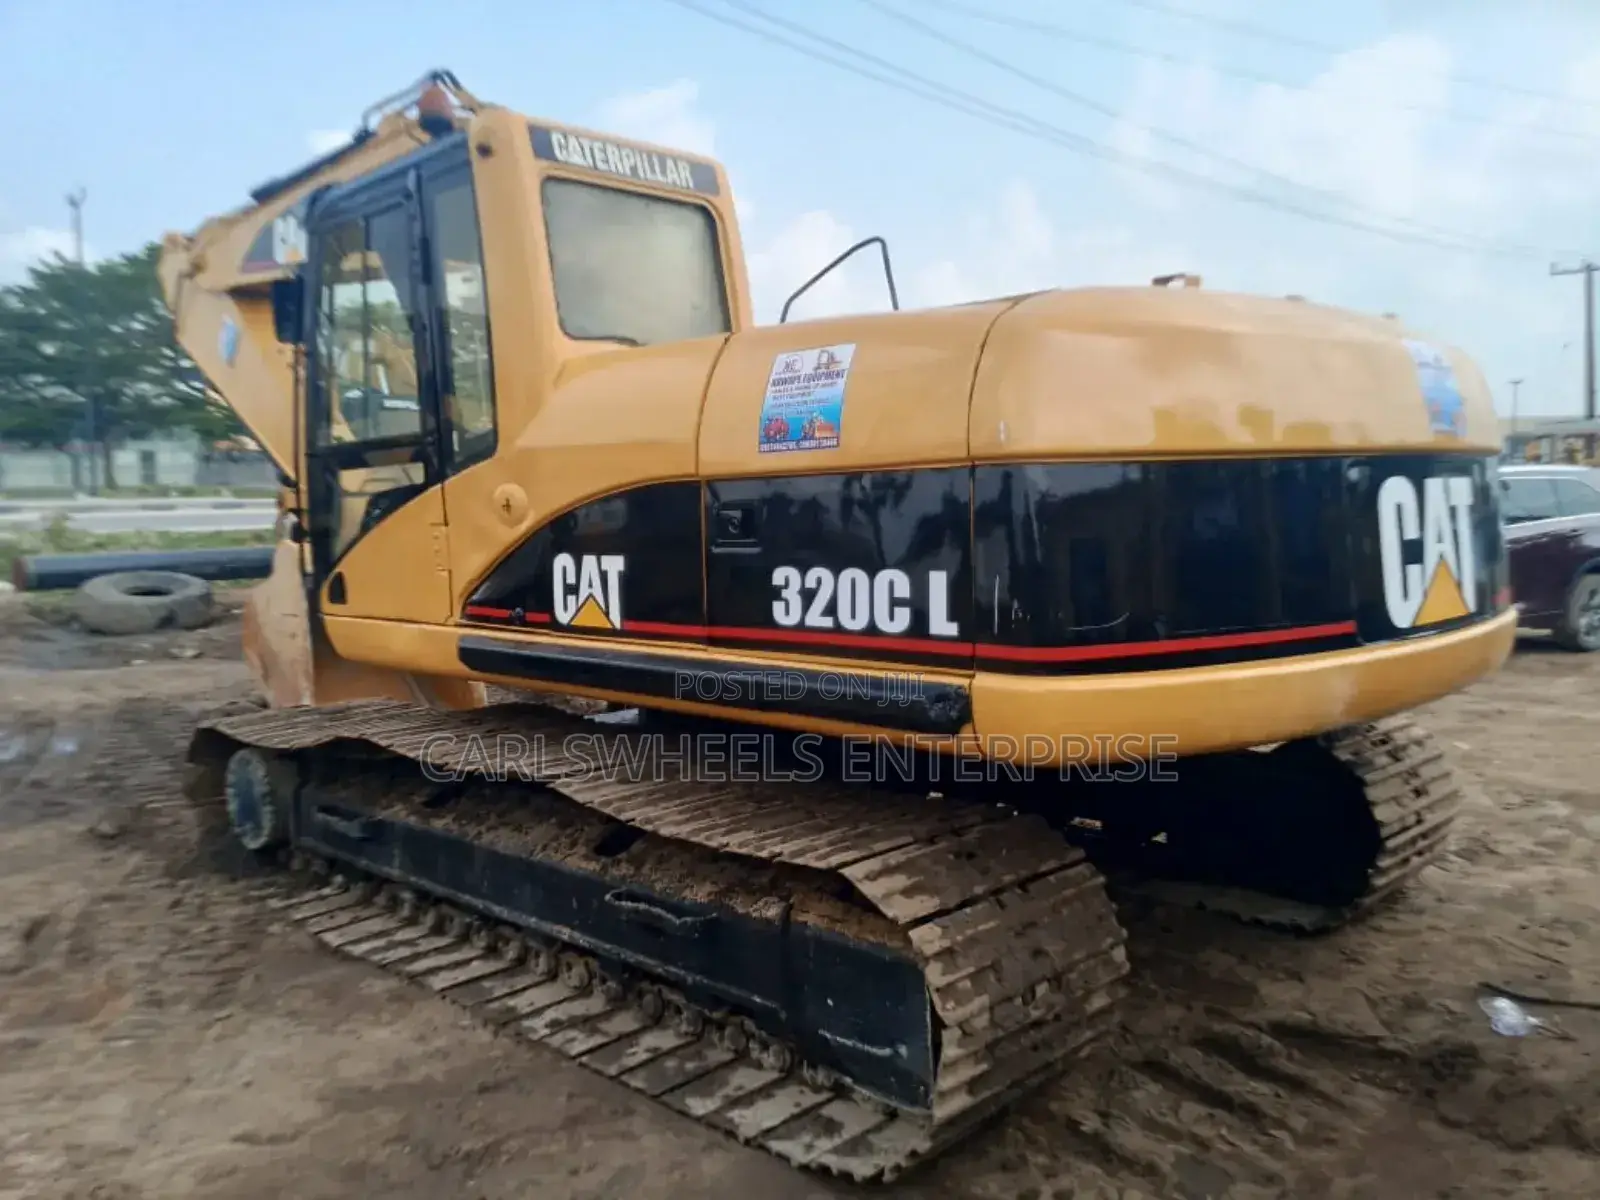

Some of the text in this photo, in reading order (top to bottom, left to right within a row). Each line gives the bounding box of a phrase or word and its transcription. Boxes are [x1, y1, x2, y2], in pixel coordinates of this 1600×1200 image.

[551, 130, 694, 189] CATERPILLAR
[273, 214, 309, 265] CA
[1377, 475, 1477, 629] CAT
[553, 552, 626, 630] CAT
[771, 566, 959, 636] 320C L
